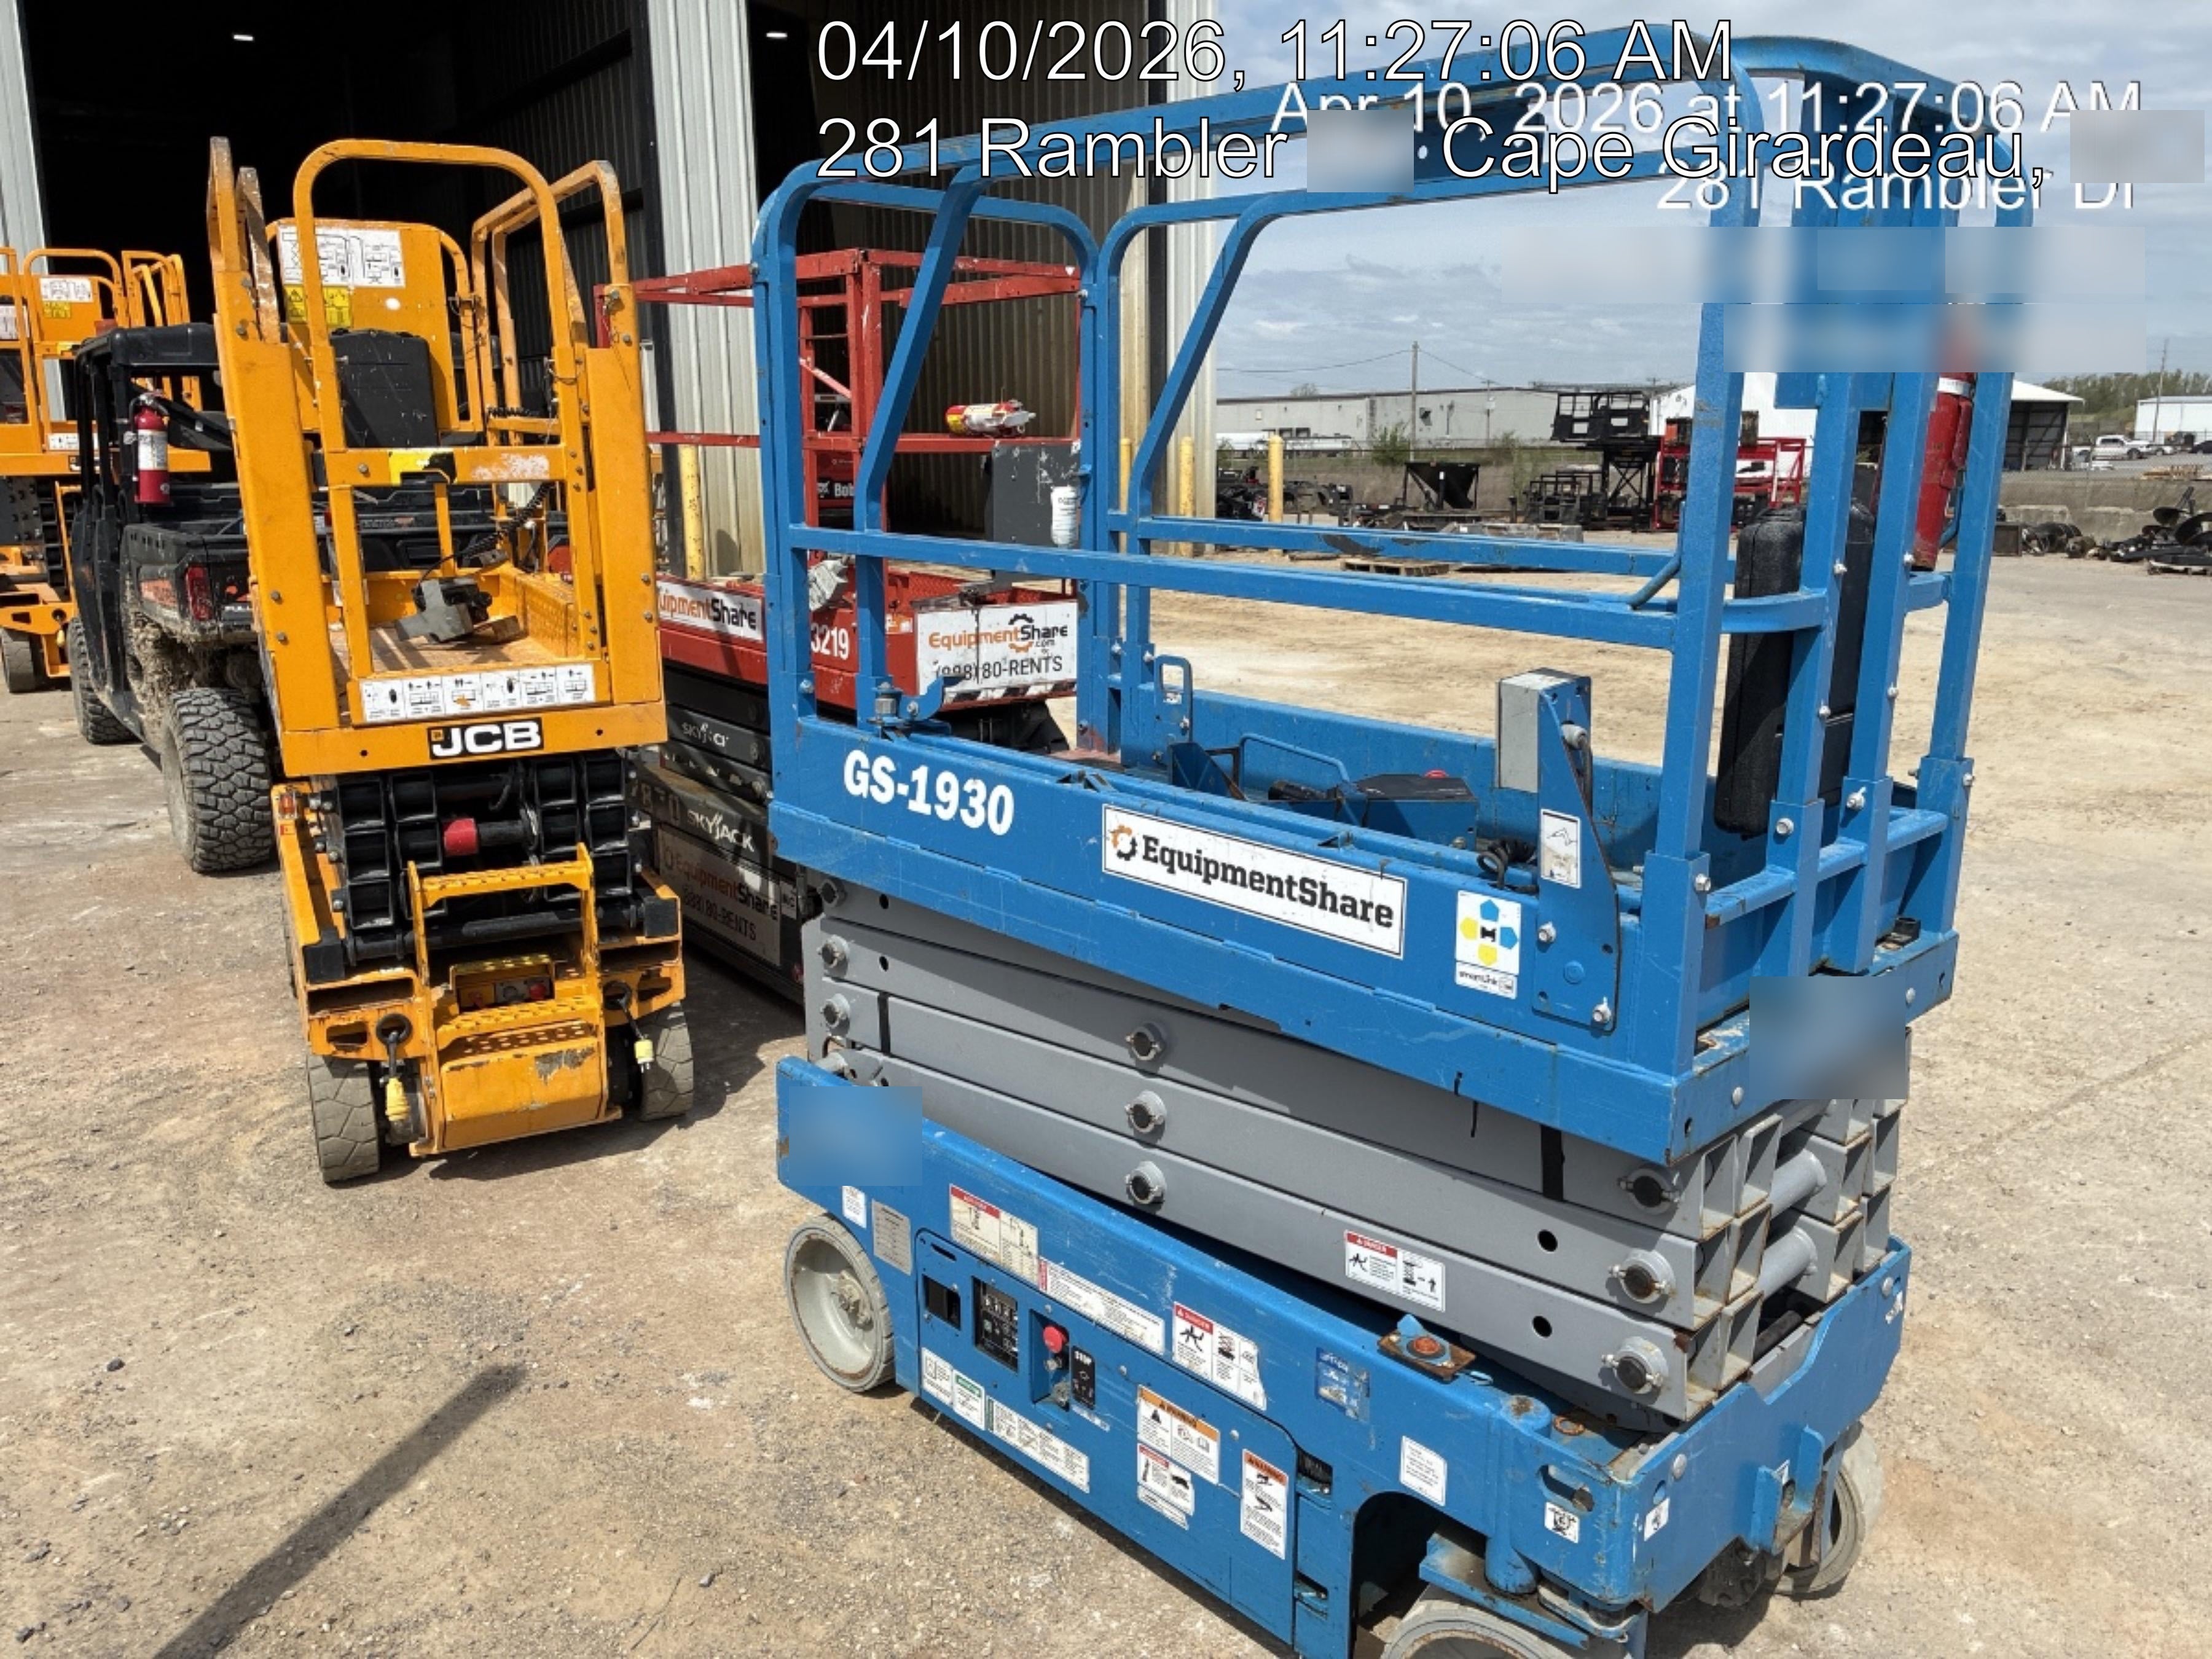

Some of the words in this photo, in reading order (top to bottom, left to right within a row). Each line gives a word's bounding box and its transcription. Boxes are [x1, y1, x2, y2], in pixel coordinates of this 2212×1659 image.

[811, 622, 850, 661] 3219
[928, 624, 1068, 651] EquipmentShare
[432, 721, 541, 756] JCB
[844, 749, 1014, 836] GS-1930
[1142, 835, 1394, 928] EquipmentShare
